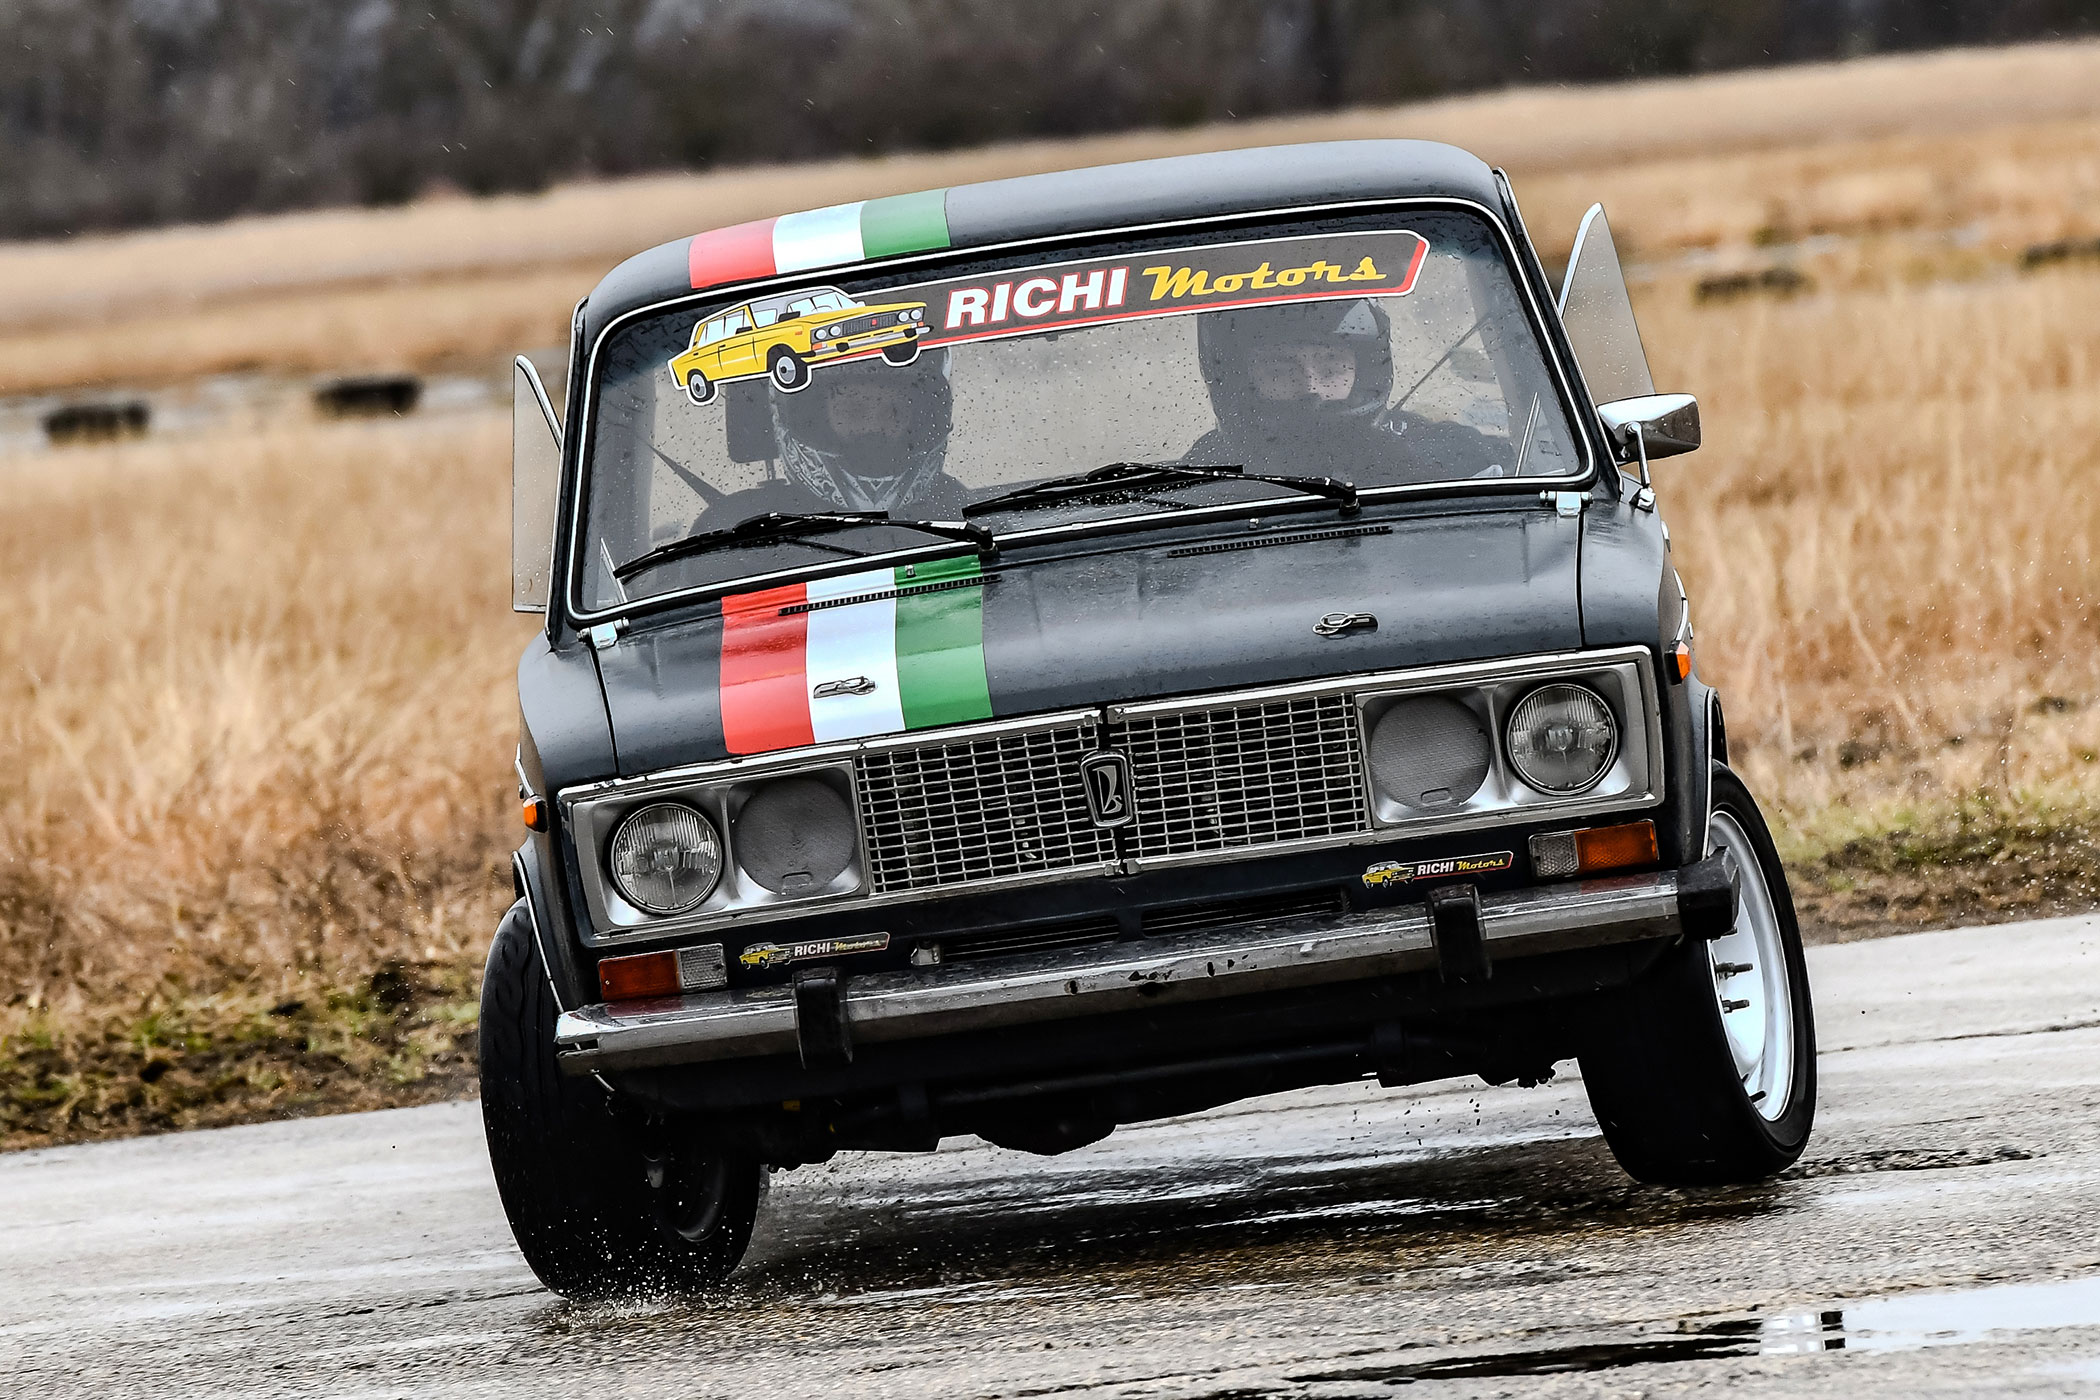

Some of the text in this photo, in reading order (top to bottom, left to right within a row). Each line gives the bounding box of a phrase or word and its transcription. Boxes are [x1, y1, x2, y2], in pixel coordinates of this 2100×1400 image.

[945, 256, 1387, 330] RICHI Motors
[1417, 859, 1504, 875] RICHI Motors
[794, 942, 830, 957] RICHI
